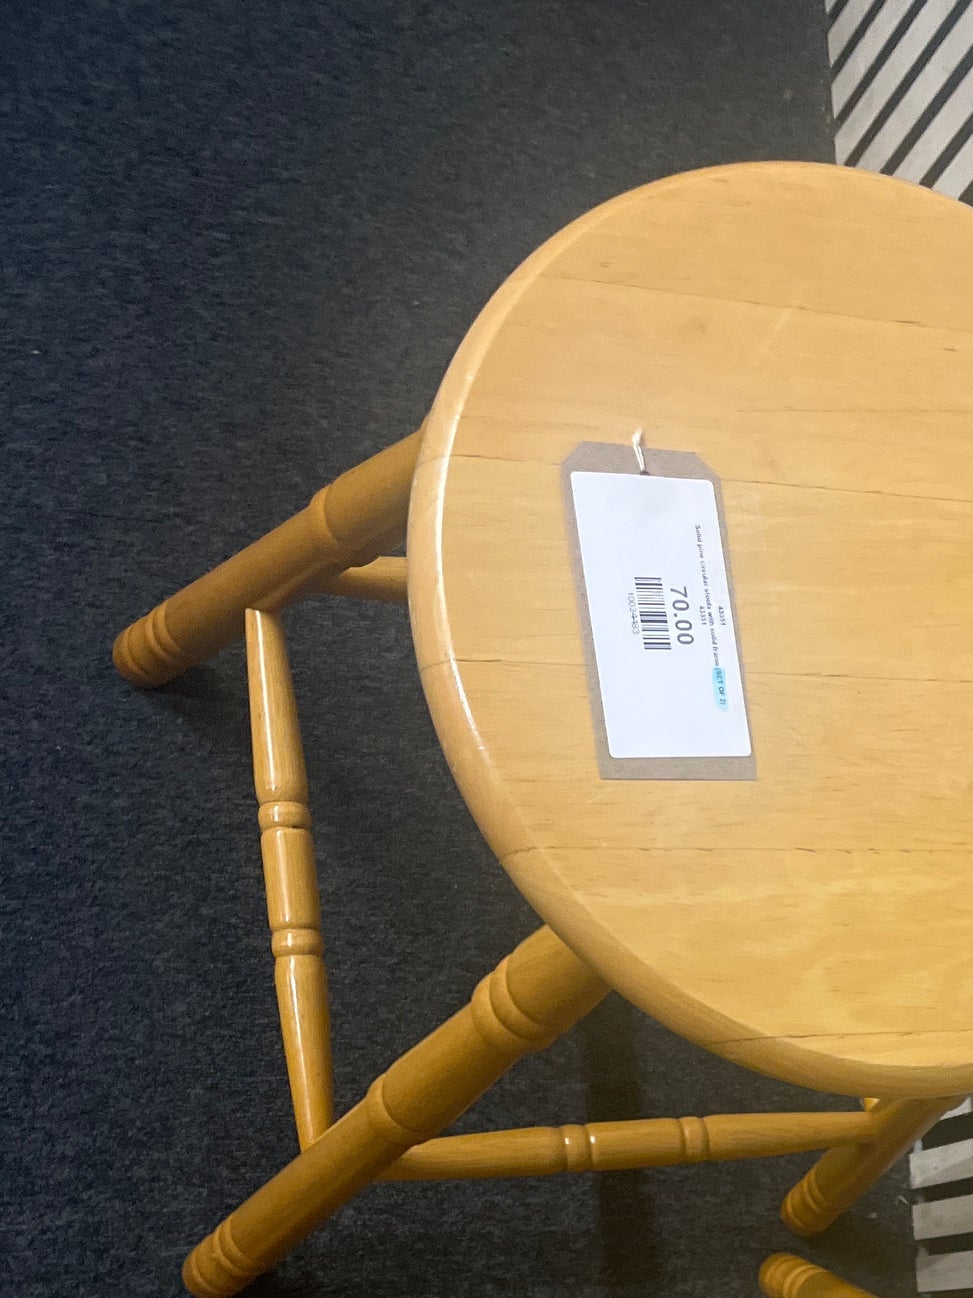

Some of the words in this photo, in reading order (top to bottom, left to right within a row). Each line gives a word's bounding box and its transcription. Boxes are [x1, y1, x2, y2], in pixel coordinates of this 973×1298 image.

[695, 525, 704, 543] Solid
[696, 543, 704, 559] pine
[700, 560, 708, 587] circular
[703, 588, 712, 610] stools
[669, 586, 695, 645] 70.00
[699, 606, 707, 626] 43351
[707, 612, 715, 626] with
[710, 628, 718, 645] solid
[718, 686, 725, 697] OF
